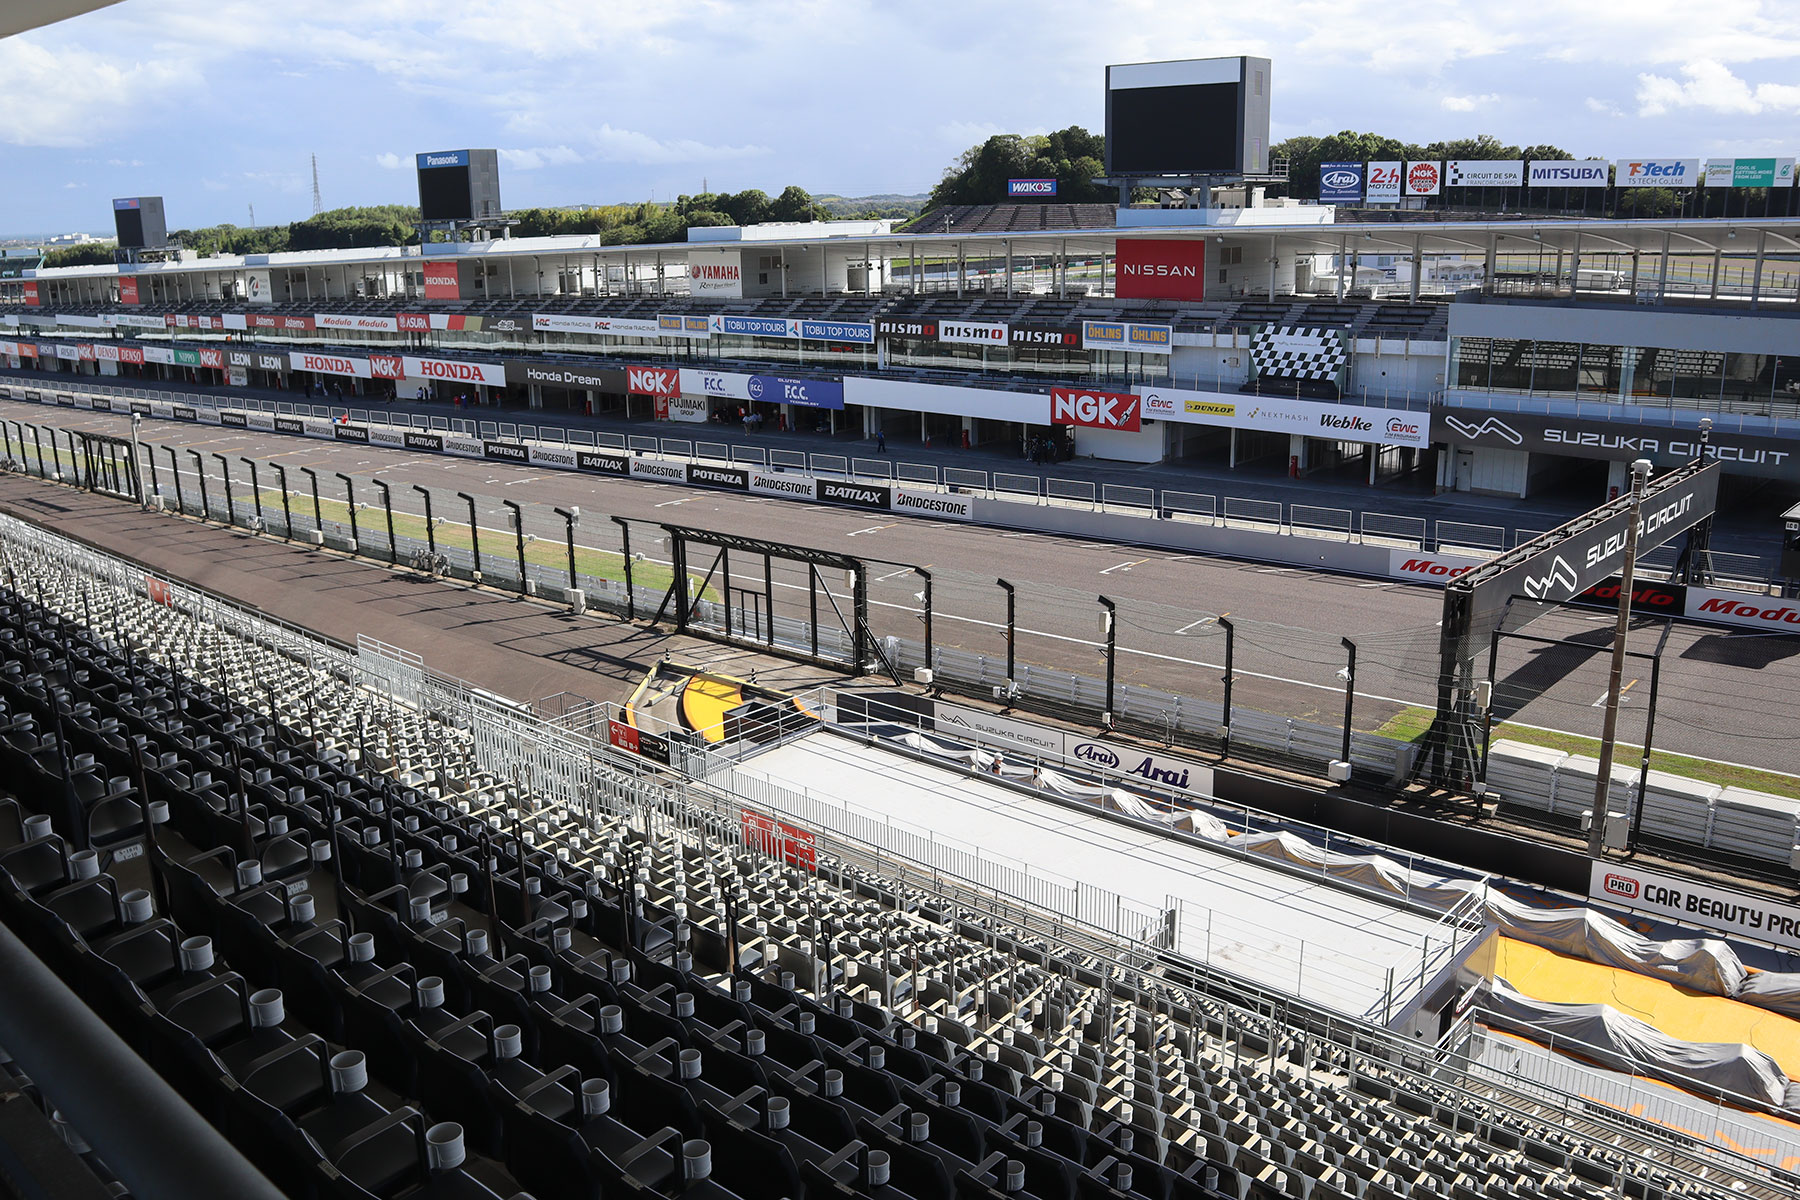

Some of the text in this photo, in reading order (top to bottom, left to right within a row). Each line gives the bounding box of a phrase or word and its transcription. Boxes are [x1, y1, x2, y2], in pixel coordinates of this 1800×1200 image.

[427, 154, 459, 165] Panasonic
[1328, 172, 1354, 184] Arai
[1413, 169, 1434, 178] NGK
[1532, 168, 1604, 180] MITSUBA
[702, 266, 740, 280] YAMAHA
[1124, 264, 1196, 277] NISSAN
[425, 277, 457, 286] HONDA
[285, 318, 305, 328] Astemo
[323, 318, 389, 328] Modulo Modulo
[406, 316, 428, 329] ASURA
[536, 318, 550, 327] HRC
[594, 322, 611, 330] HRC
[727, 320, 786, 332] TOBU TOP TOURS
[880, 322, 935, 335] nismo
[805, 325, 870, 338] TOBU TOP TOURS
[944, 326, 1003, 340] nismo
[1013, 330, 1077, 344] nismo
[1088, 324, 1167, 342] ÖHLINS ÖHLINS
[98, 346, 116, 359] DENSO
[121, 349, 141, 362] DENSO
[179, 352, 196, 363] NIPPO
[200, 351, 218, 366] NGK
[230, 352, 282, 370] LEON LEON
[304, 356, 356, 374] HONDA
[371, 358, 397, 377] NGK
[420, 361, 486, 382] HONDA
[527, 368, 602, 386] Honda Dream
[629, 370, 668, 394] NGK
[704, 377, 726, 392] F.C.C.
[784, 385, 809, 400] F.C.C.
[669, 397, 706, 411] FUJIMAKI
[1055, 392, 1119, 426] NGK
[1150, 400, 1174, 409] EWC
[1194, 405, 1234, 414] DUNLOP
[1261, 411, 1309, 422] NEXTHASH
[338, 428, 366, 438] POTENZA
[1392, 424, 1419, 434] EWC
[371, 432, 402, 444] BRIDGESTONE
[446, 440, 482, 454] BRIDGESTONE
[488, 445, 524, 459] POTENZA
[1543, 429, 1789, 465] SUZUKA CIRCUIT
[532, 450, 574, 466] BRIDGESTONE
[582, 456, 624, 471] BATTLAX
[634, 462, 683, 479] BRIDGESTONE
[692, 469, 742, 486] POTENZA
[754, 476, 812, 496] BRIDGESTONE
[825, 485, 882, 504] BATTLAX
[897, 494, 968, 516] BRIDGESTONE
[1586, 493, 1694, 569] SUZUA CIRCUIT
[1400, 559, 1476, 578] Mod
[1698, 598, 1800, 624] Modu
[975, 724, 1056, 748] SUZUKA CIRCUIT
[1081, 746, 1191, 789] Arai Arai
[1610, 879, 1633, 893] PRO
[1644, 884, 1681, 910] CAR
[1686, 893, 1764, 929] BEAUTY
